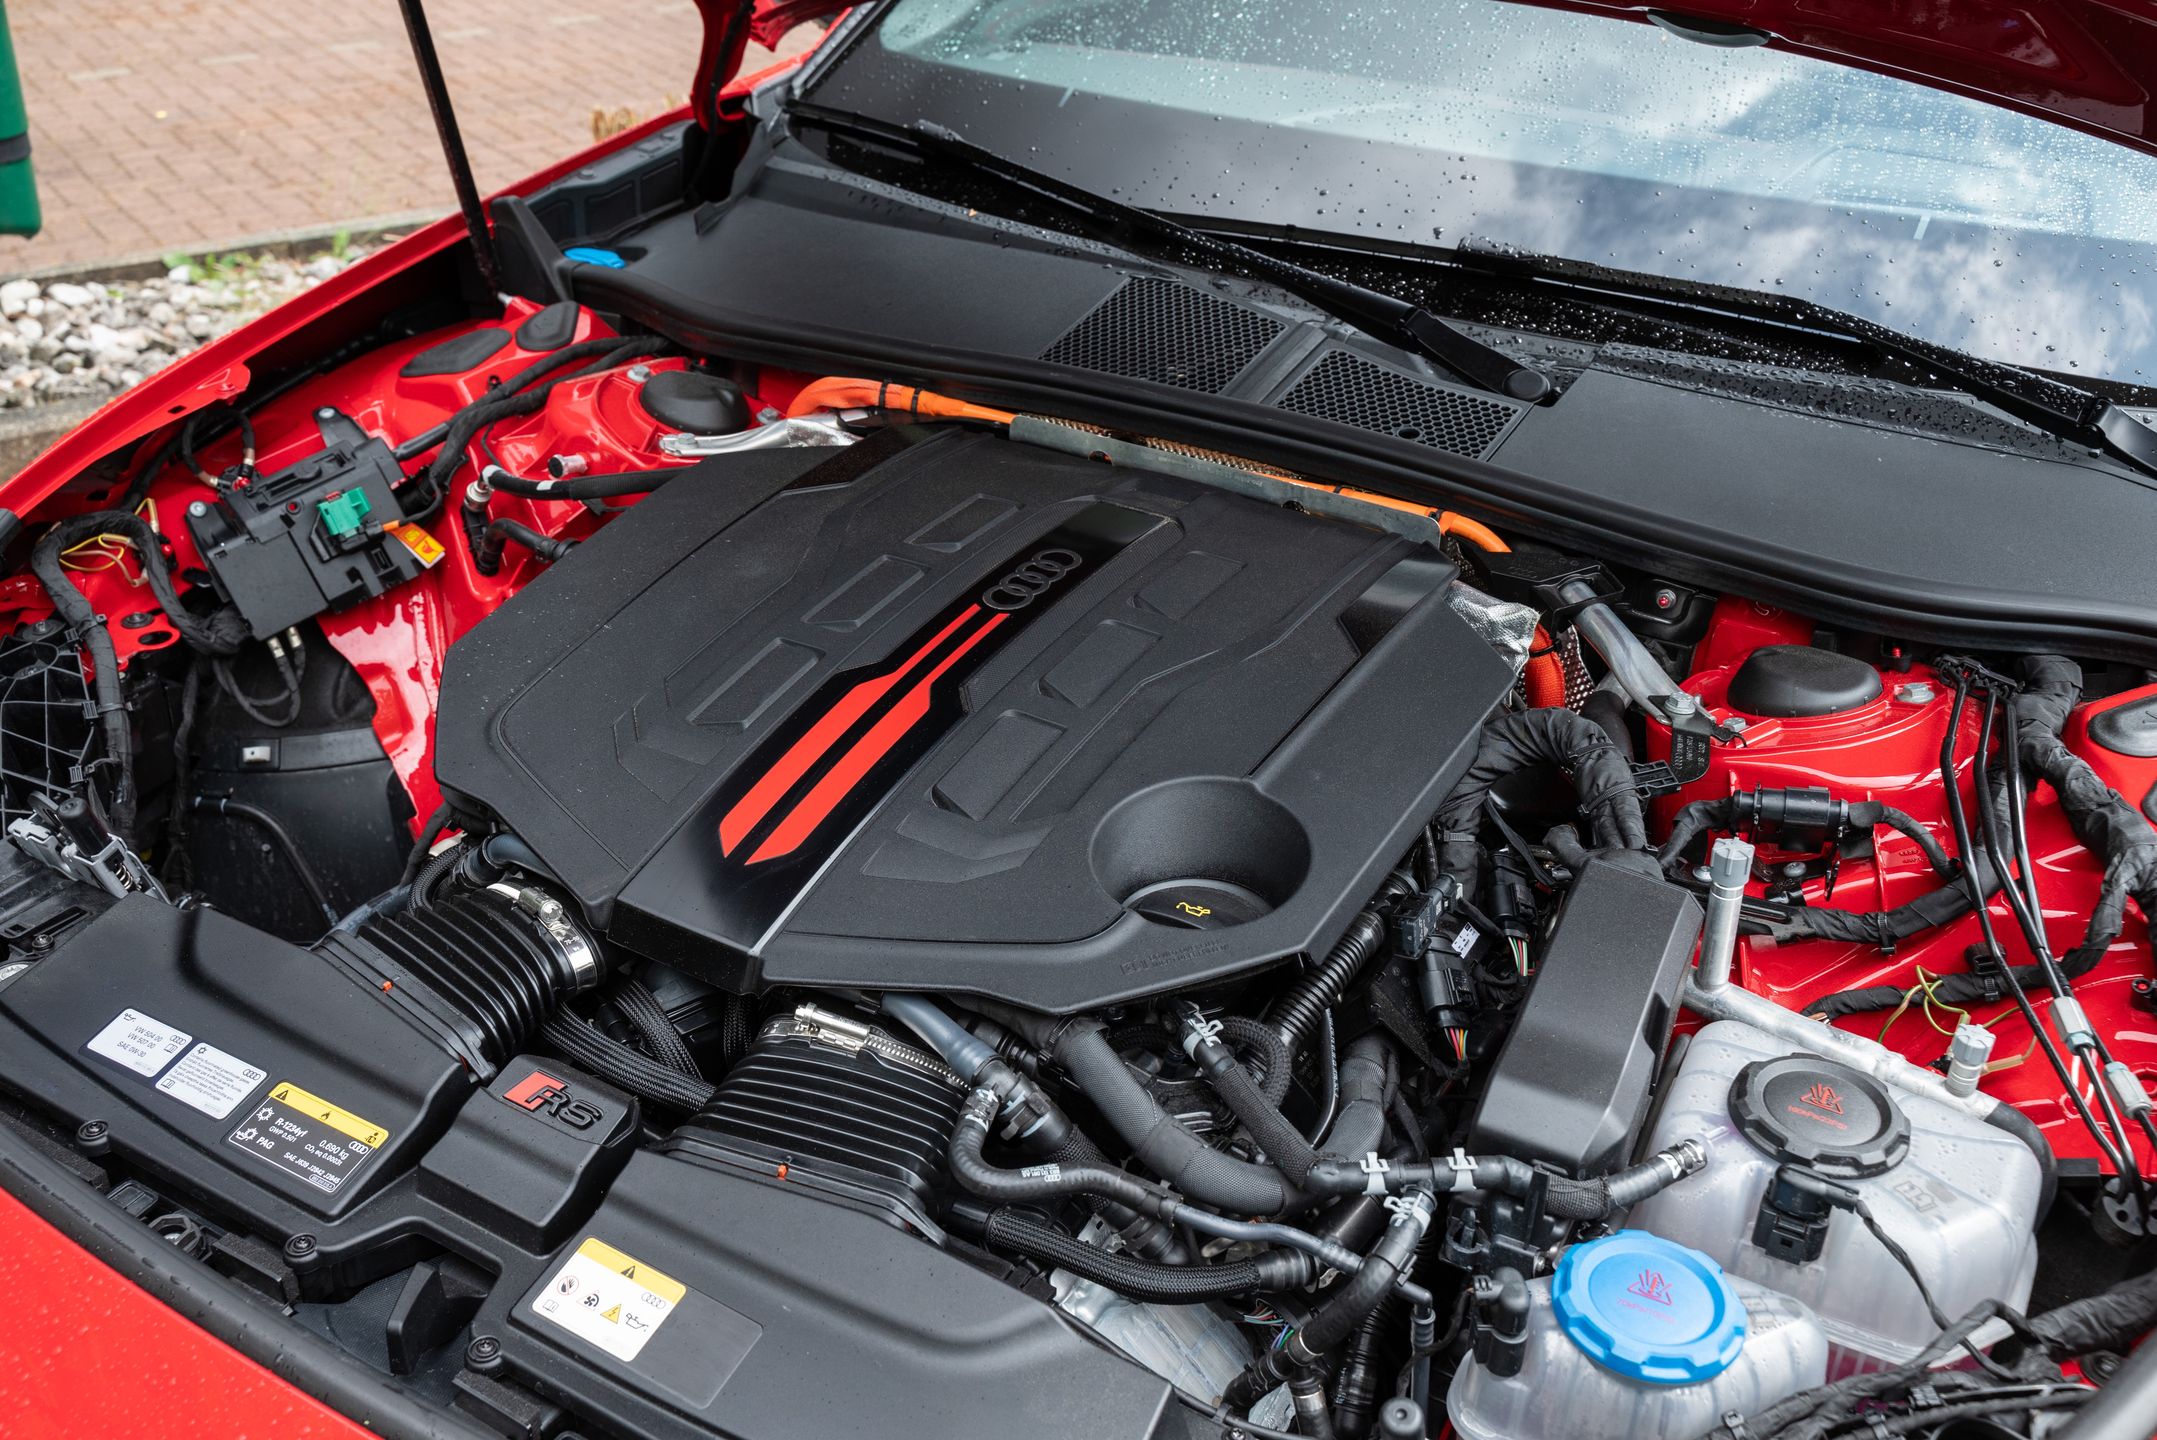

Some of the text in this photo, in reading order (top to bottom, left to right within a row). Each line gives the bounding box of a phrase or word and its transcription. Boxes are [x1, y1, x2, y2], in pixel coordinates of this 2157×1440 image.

[134, 1026, 146, 1034] VW
[128, 1032, 138, 1040] VW
[116, 1041, 130, 1050] SAE
[522, 1083, 604, 1130] RS
[269, 1126, 283, 1136] GWP
[275, 1118, 308, 1137] R-1234yf
[256, 1136, 275, 1150] PAG
[319, 1139, 349, 1160] 0.690 kg
[284, 1151, 296, 1162] SAE
